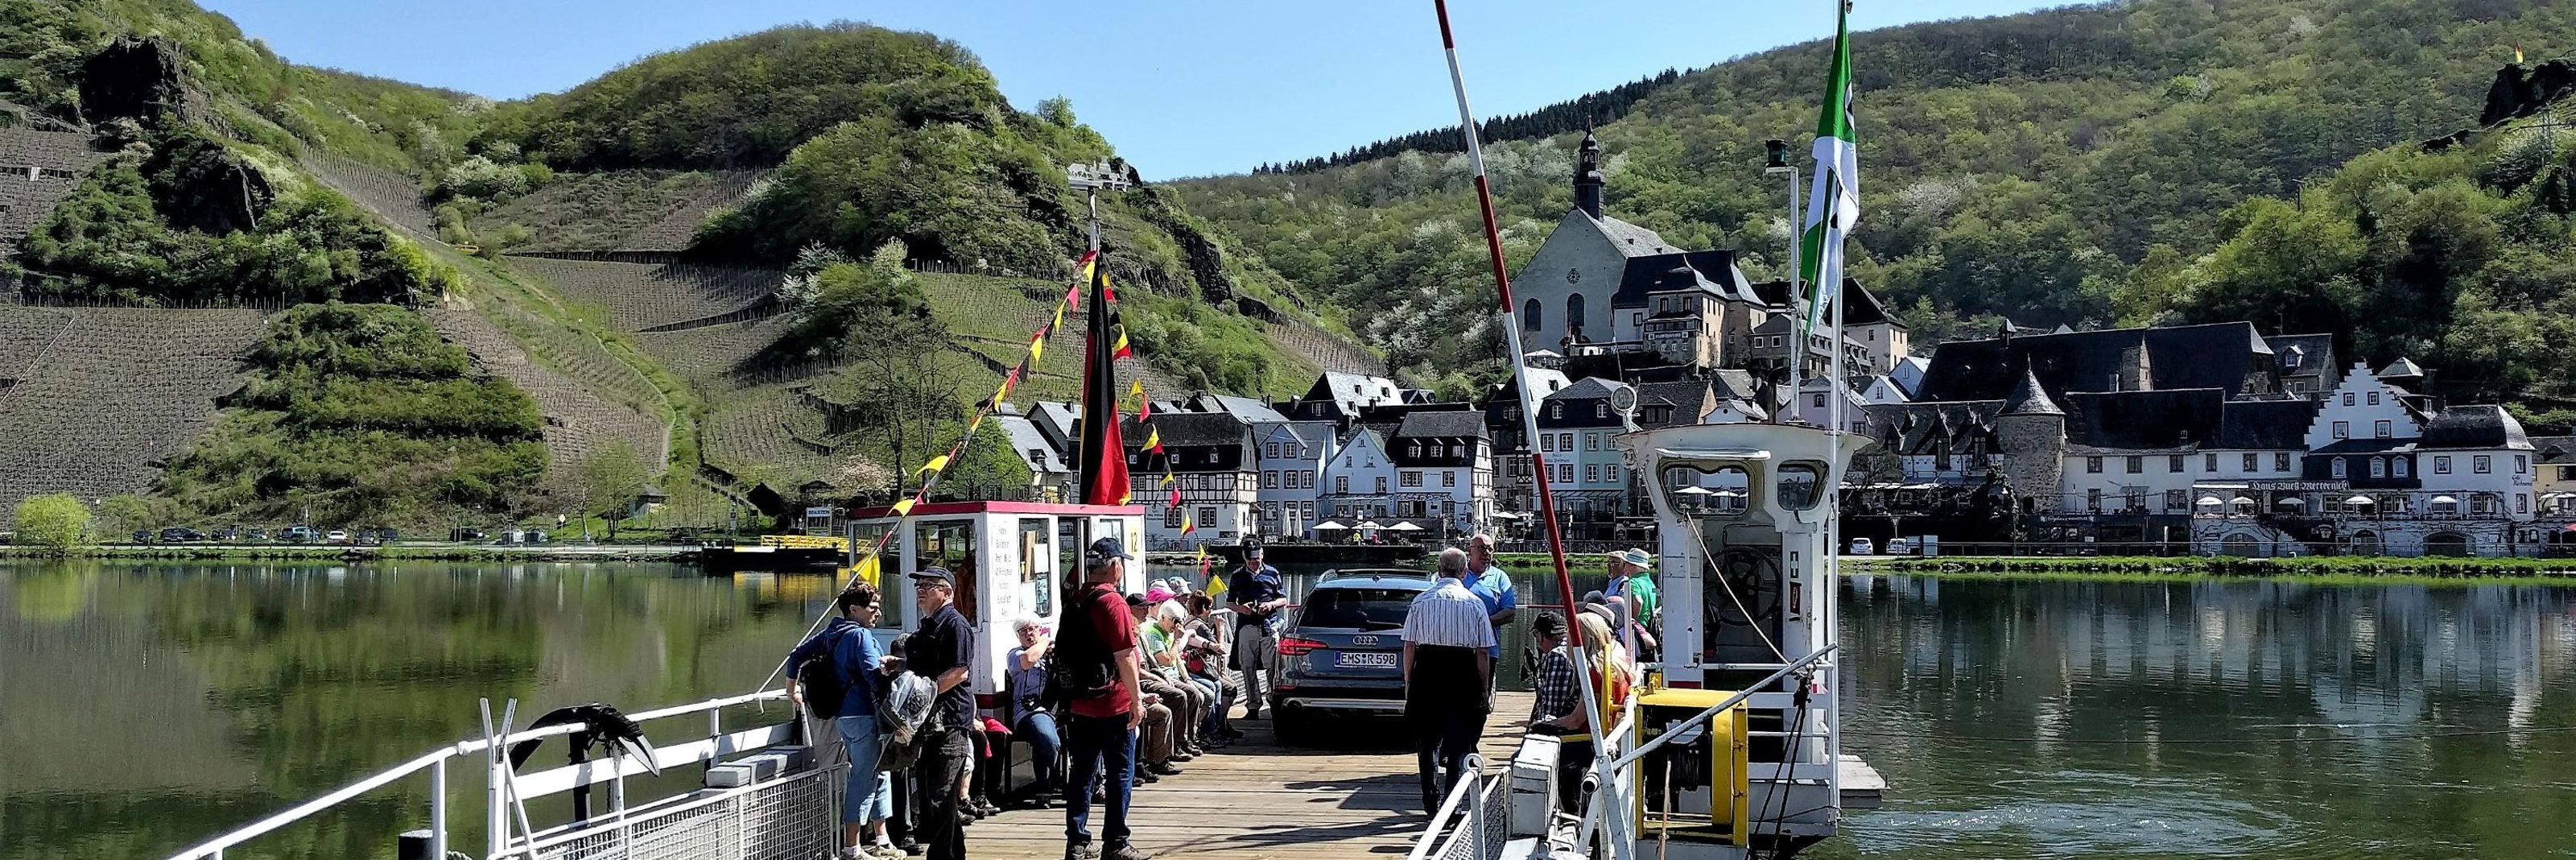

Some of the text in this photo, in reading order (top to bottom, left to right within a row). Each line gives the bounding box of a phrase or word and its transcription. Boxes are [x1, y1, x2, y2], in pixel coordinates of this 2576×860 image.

[1131, 532, 1137, 552] 12
[1341, 653, 1395, 665] EMS R 598
